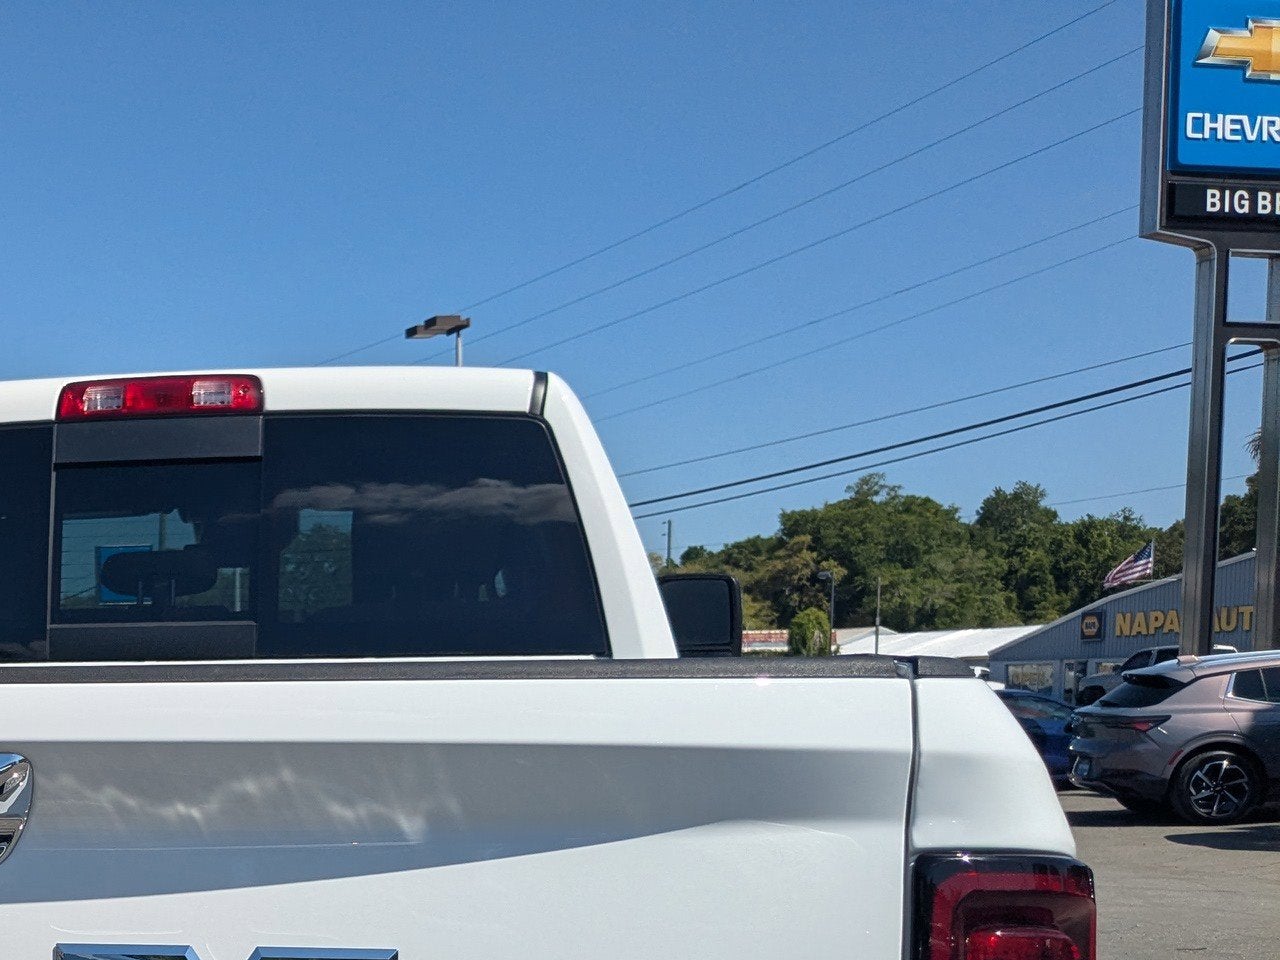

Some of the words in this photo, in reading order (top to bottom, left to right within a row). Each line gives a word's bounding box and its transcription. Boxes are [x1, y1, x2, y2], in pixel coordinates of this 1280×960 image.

[1186, 112, 1280, 142] CHEVR
[1205, 188, 1250, 214] BIG
[1115, 610, 1180, 637] NAPA
